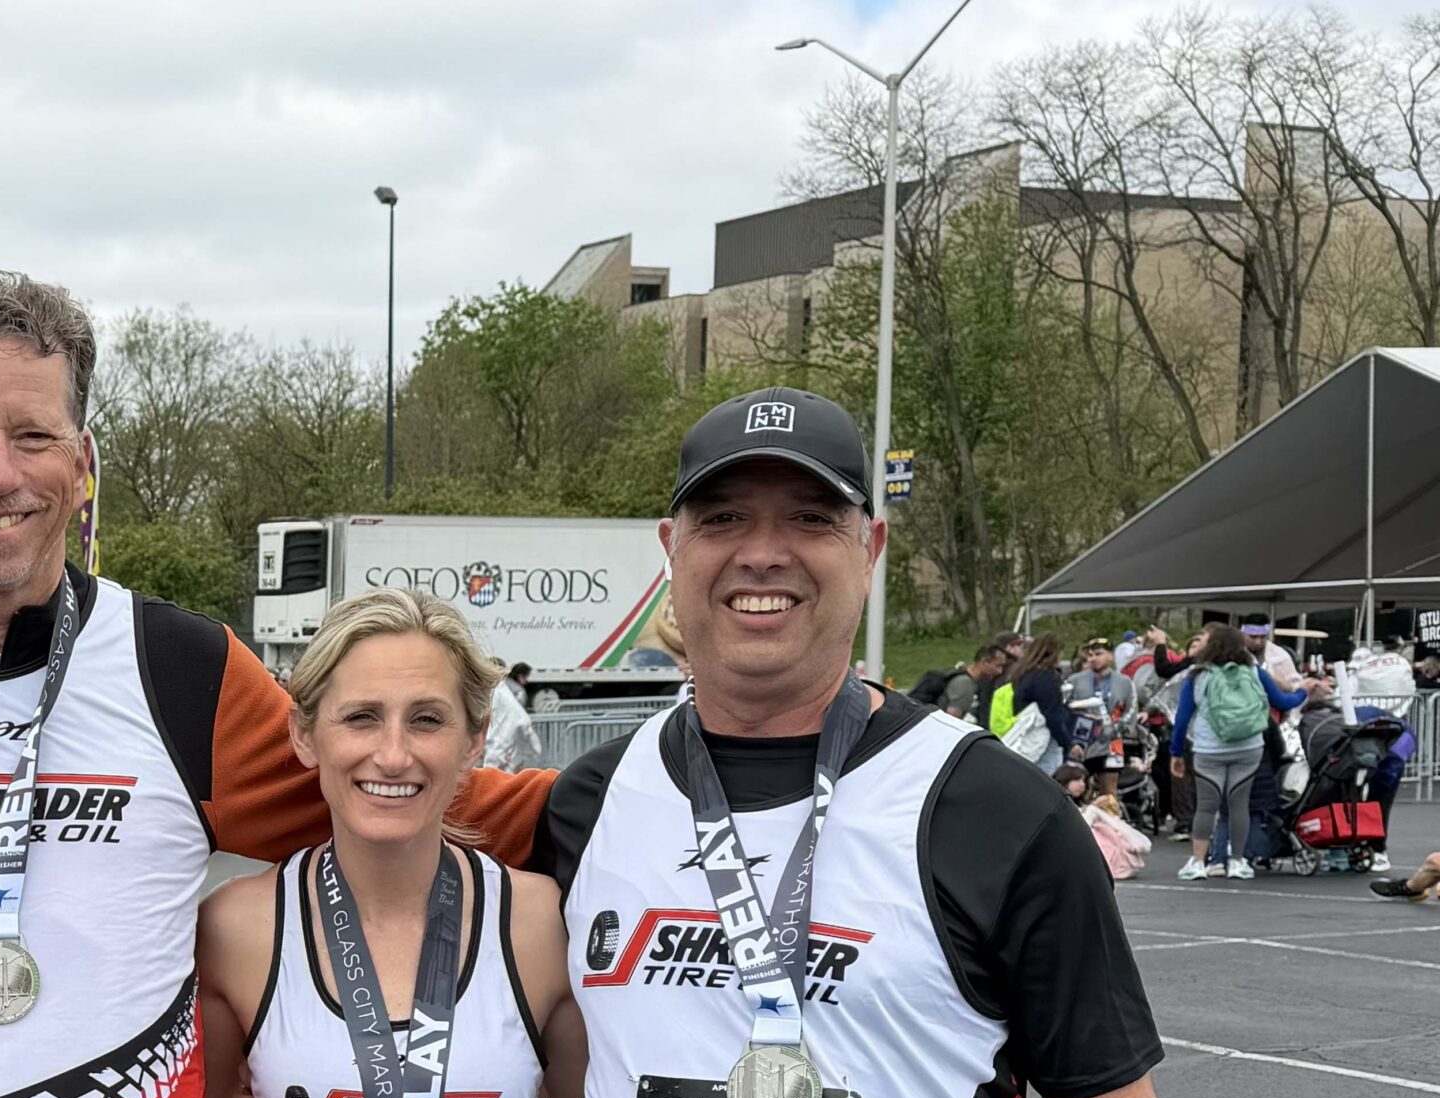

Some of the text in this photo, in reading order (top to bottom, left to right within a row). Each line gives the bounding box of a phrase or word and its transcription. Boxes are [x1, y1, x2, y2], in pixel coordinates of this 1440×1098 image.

[365, 567, 609, 604] SOFO FOODS
[493, 617, 555, 634] Dependable
[58, 824, 121, 843] OIL
[695, 816, 777, 969] RELAY
[779, 846, 815, 965] RATHON
[649, 925, 859, 982] SHRER
[333, 910, 364, 981] GLASS
[352, 988, 381, 1035] CITY
[643, 966, 734, 988] TIRE
[742, 968, 782, 981] FINISHER
